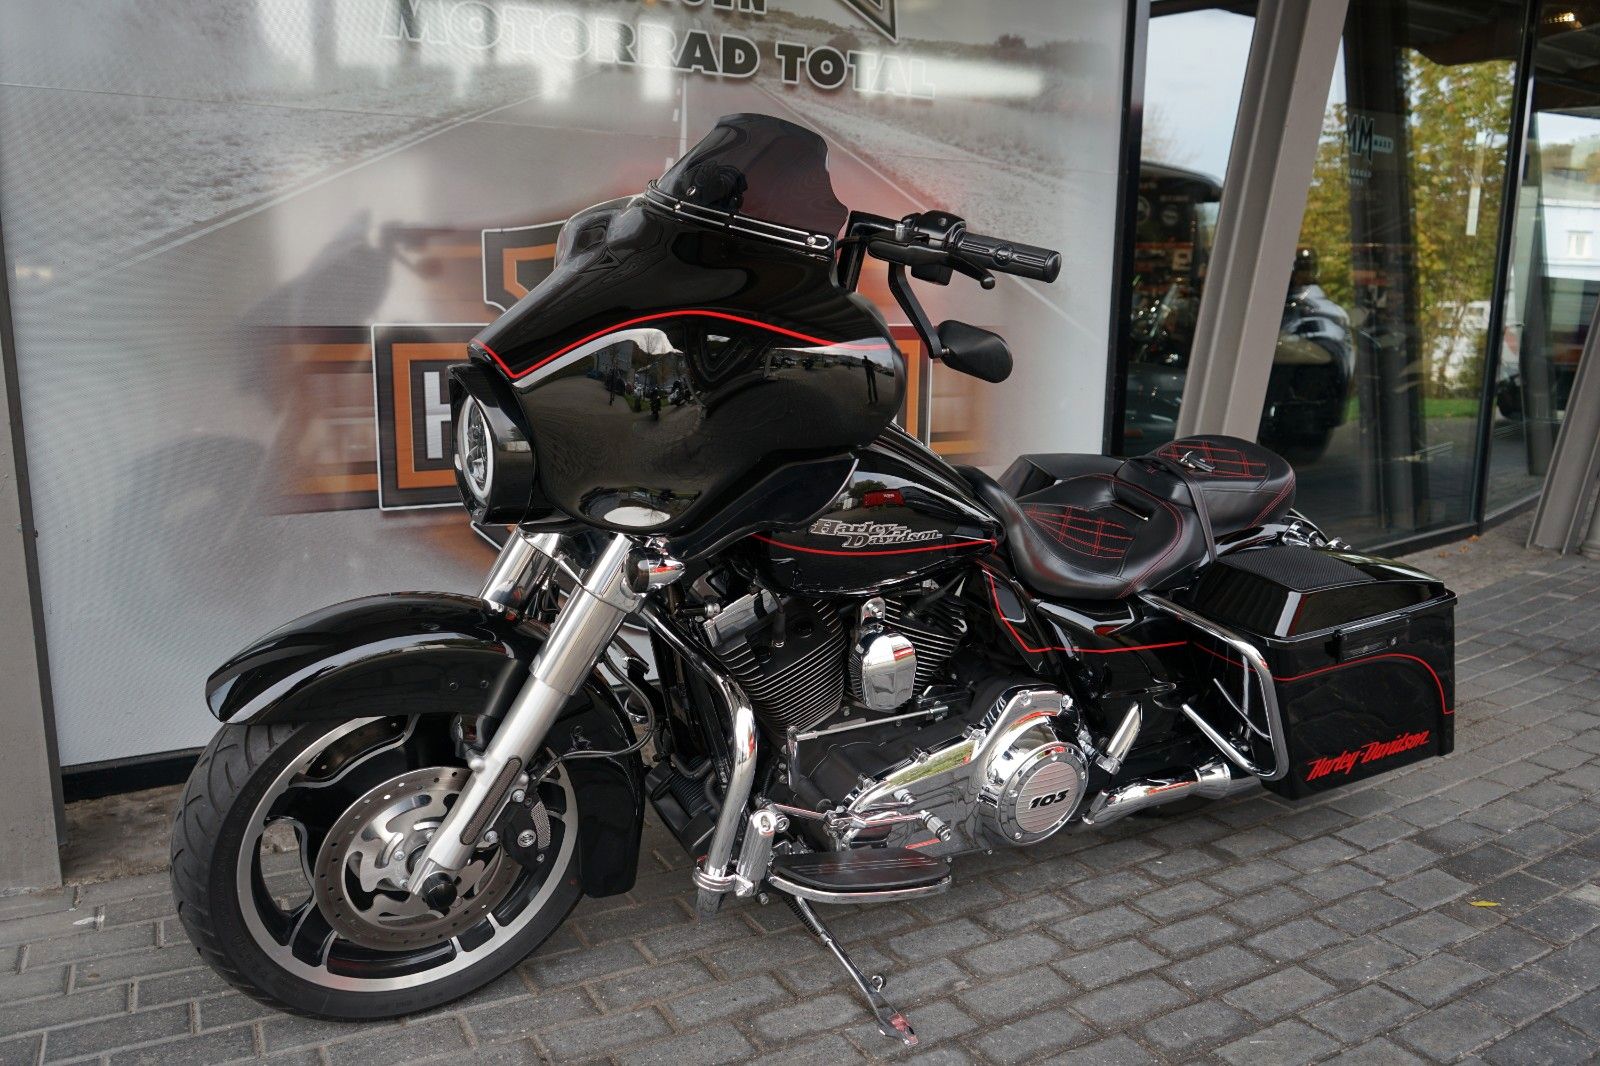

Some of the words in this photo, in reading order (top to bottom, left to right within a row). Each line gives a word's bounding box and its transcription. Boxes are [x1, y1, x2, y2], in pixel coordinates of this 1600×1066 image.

[379, 0, 761, 78] MOTORRAD
[775, 40, 936, 98] TOTAL
[842, 528, 943, 548] Davidson
[1305, 729, 1430, 782] Harley-Davidson
[1028, 787, 1071, 810] 103
